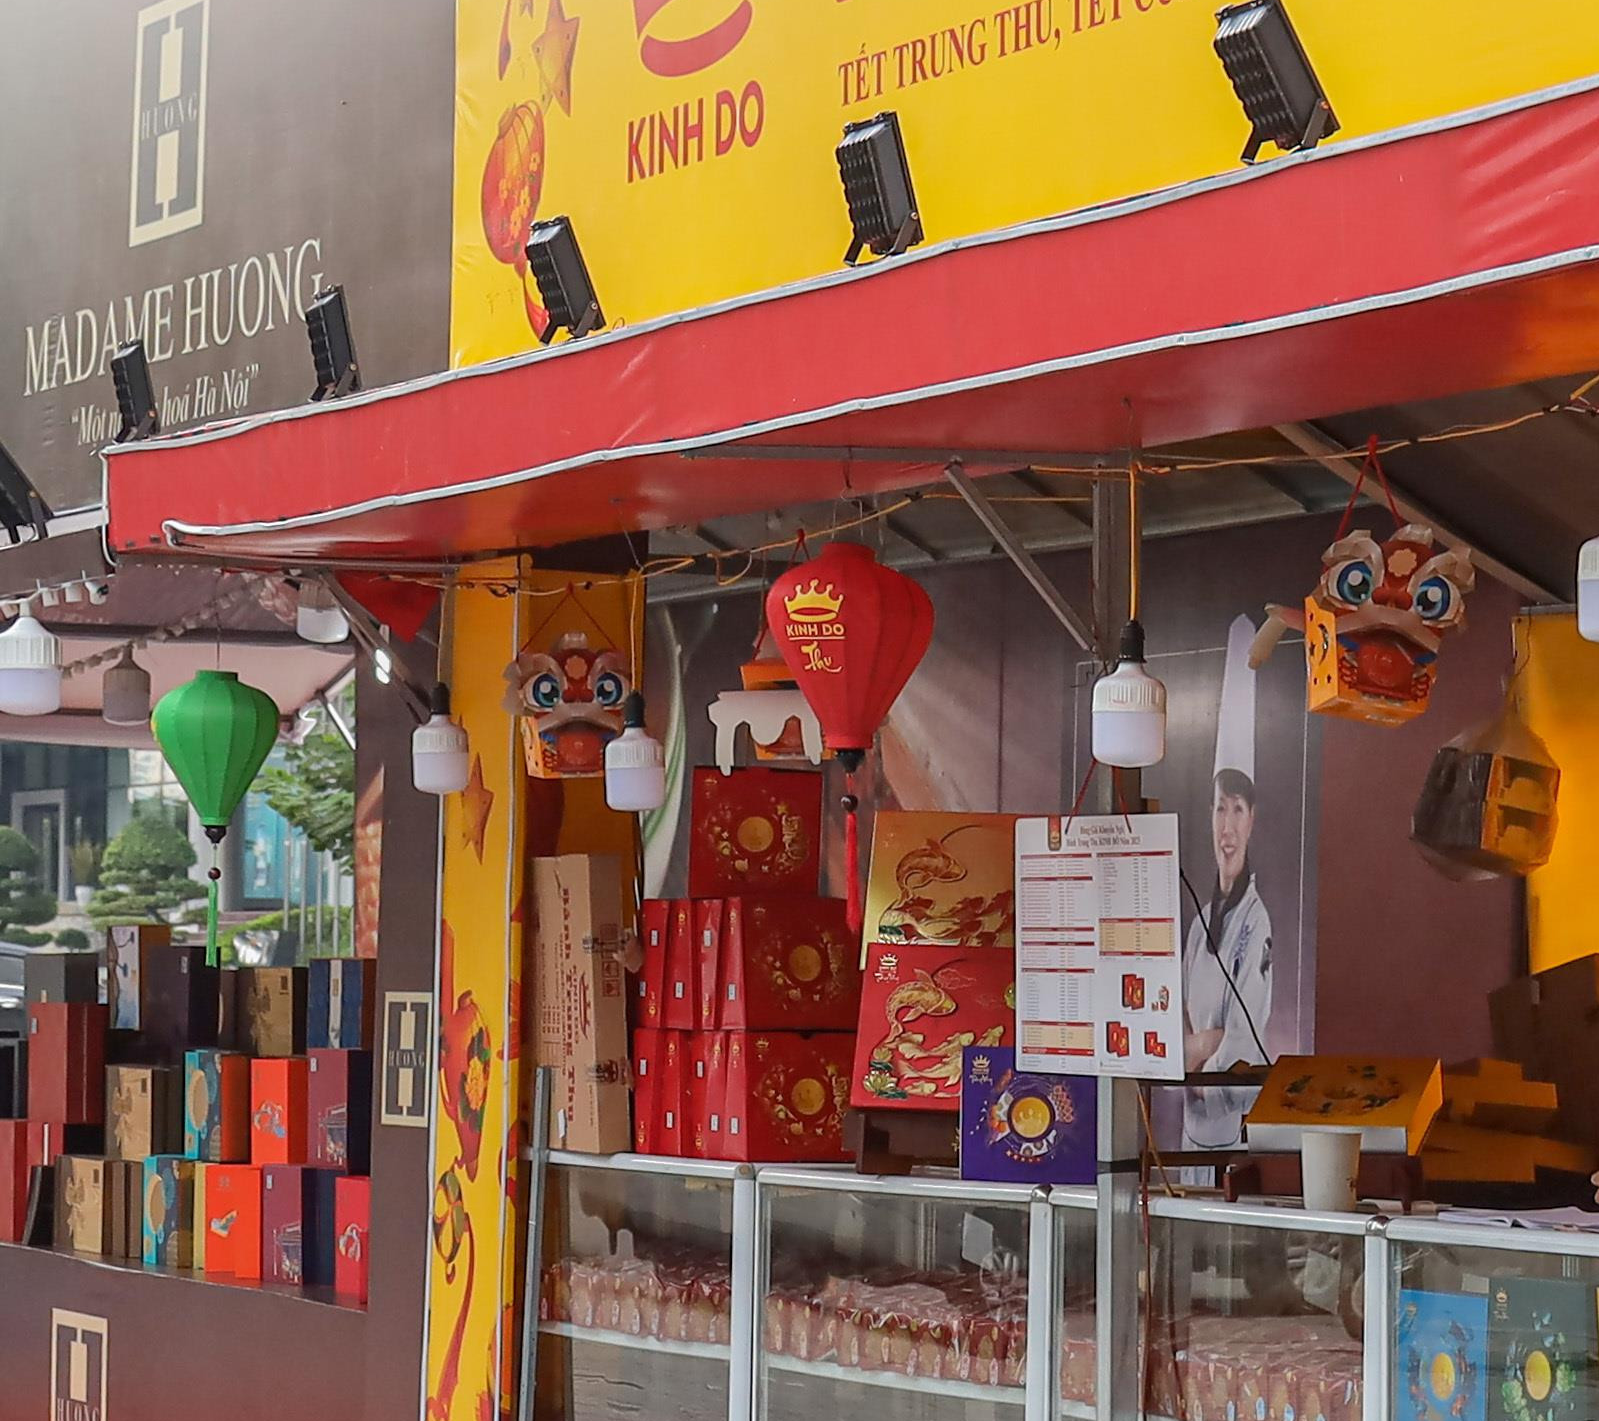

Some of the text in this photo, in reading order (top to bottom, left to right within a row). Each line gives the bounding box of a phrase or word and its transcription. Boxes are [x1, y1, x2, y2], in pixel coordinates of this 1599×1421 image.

[838, 38, 888, 107] TẾT
[893, 17, 988, 90] TRUNG
[141, 93, 197, 141] HUONG
[626, 79, 764, 182] KINH DO
[24, 238, 326, 396] MADAME HUONG
[786, 624, 844, 637] KINH DO
[389, 1049, 425, 1068] HUONG
